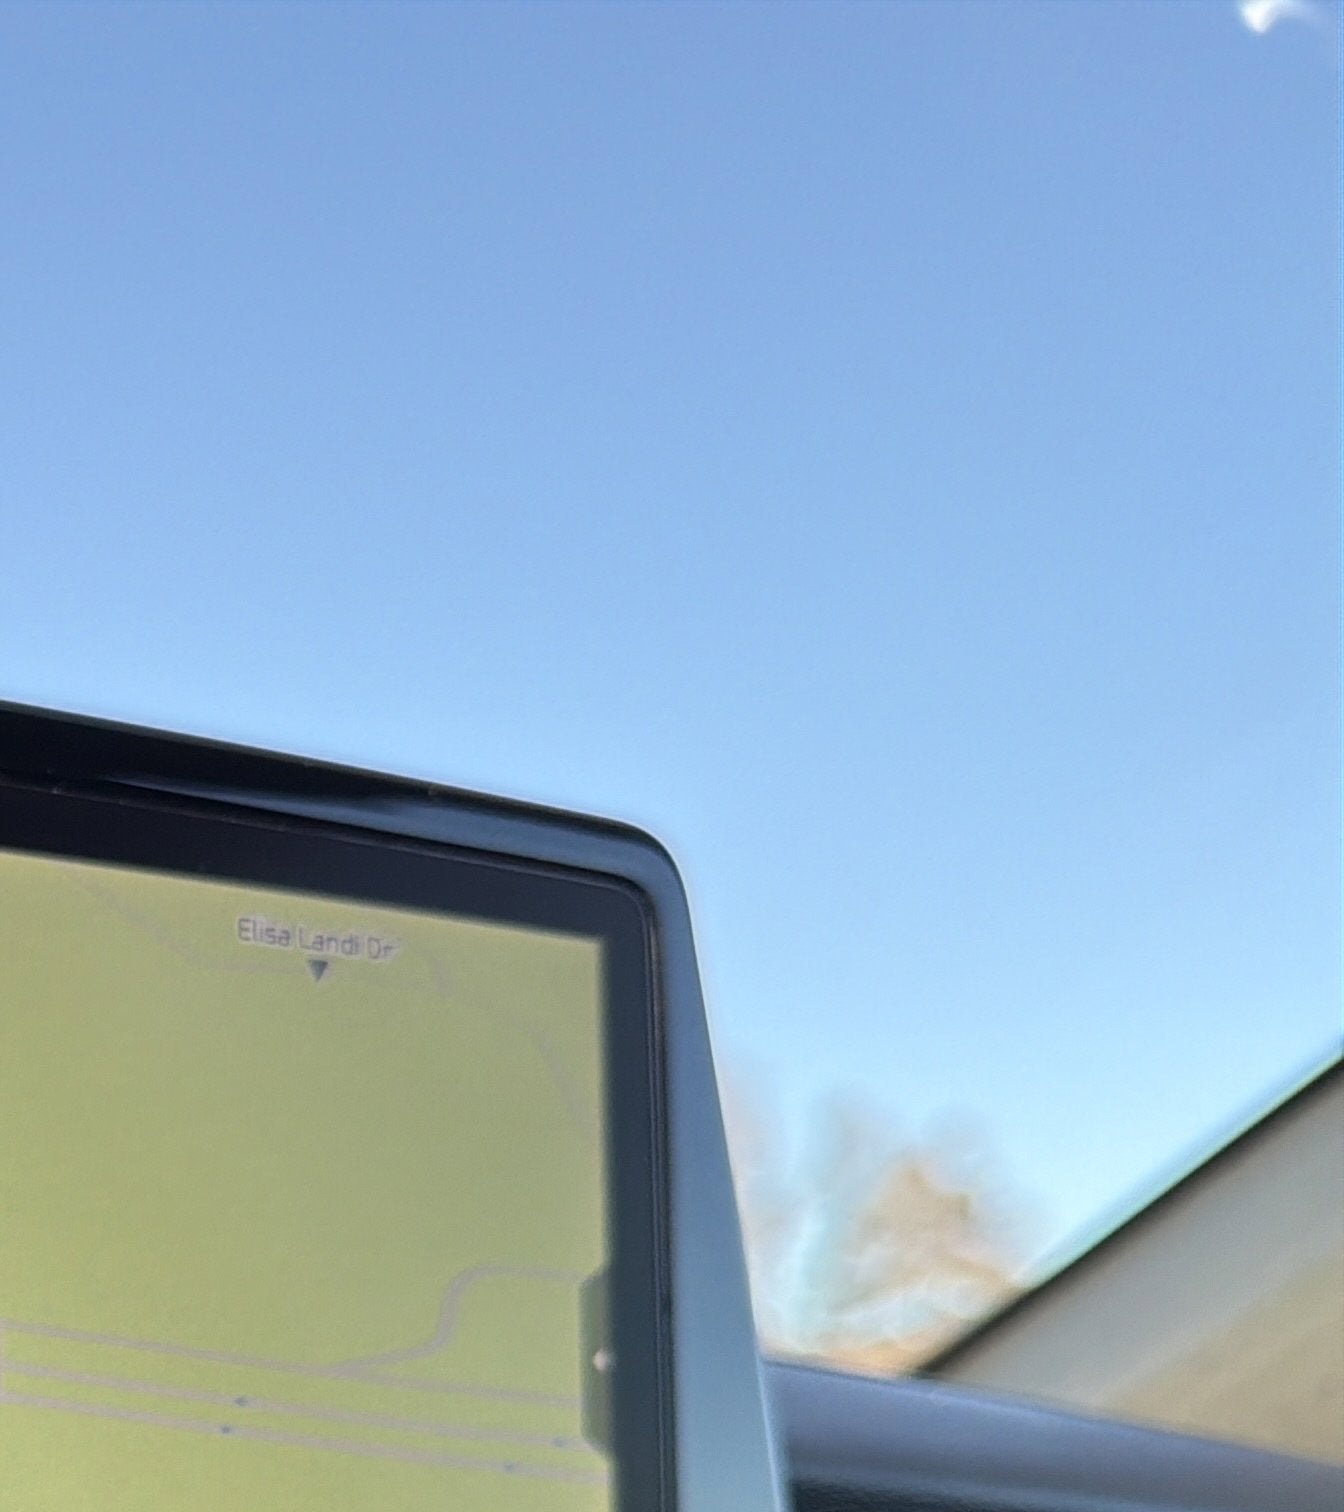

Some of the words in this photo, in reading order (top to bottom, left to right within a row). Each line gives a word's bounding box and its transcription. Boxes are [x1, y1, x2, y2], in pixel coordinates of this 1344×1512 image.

[237, 918, 291, 947] Elisa
[298, 927, 360, 956] Landi
[366, 936, 396, 959] Dr
